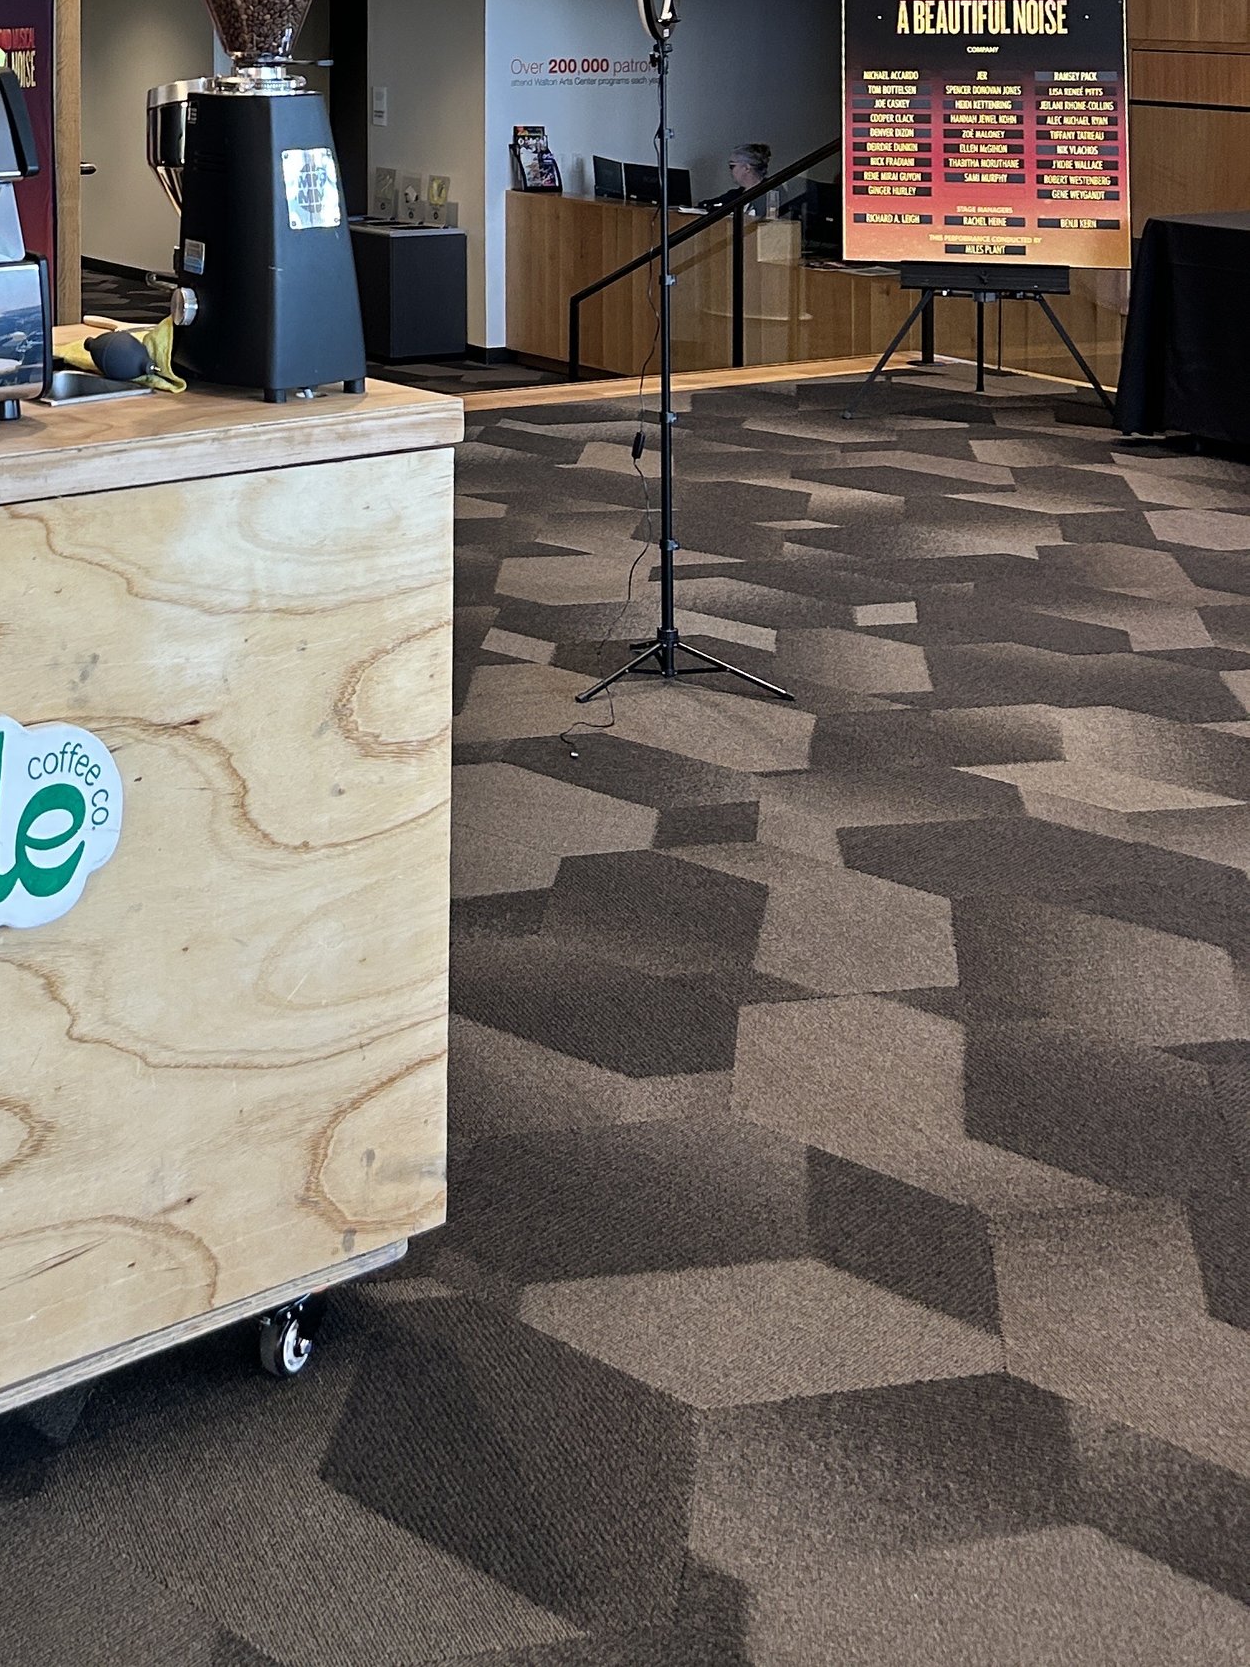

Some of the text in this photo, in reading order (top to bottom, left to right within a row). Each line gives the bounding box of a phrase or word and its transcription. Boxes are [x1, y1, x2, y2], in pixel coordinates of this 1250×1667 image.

[896, 0, 1069, 35] A BEAUTIFUL NOISE
[510, 58, 657, 76] Over 200,000 patro
[1080, 72, 1098, 81] PACK
[559, 78, 573, 86] Arts
[574, 78, 597, 86] Center
[868, 85, 882, 94] TOM
[945, 85, 972, 94] SPENCER
[1048, 88, 1063, 96] LISA
[874, 99, 886, 108] JOE
[1046, 116, 1062, 125] ALEC
[963, 216, 986, 226] RACHEL
[27, 740, 110, 831] coffee co.
